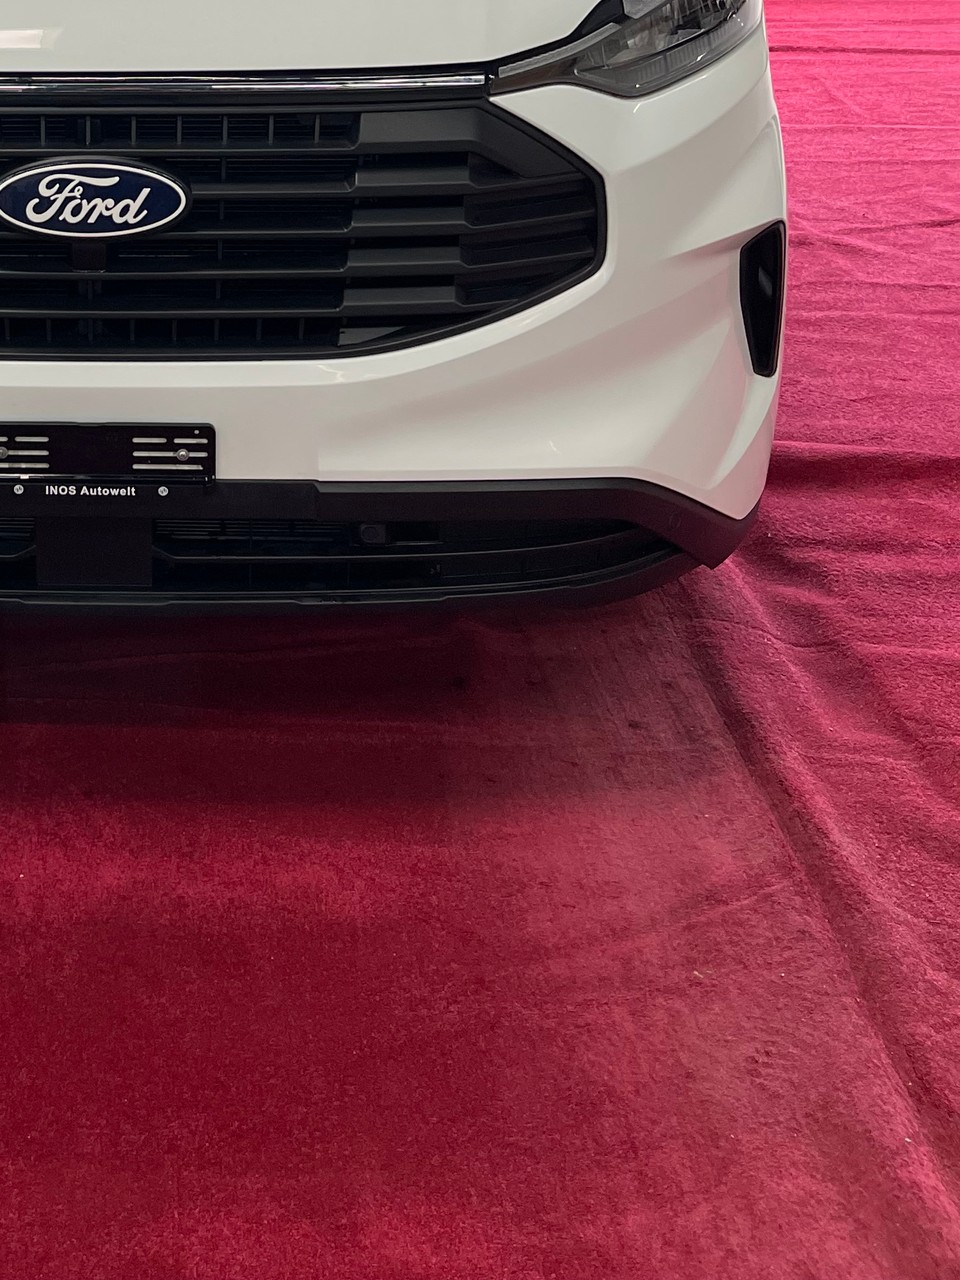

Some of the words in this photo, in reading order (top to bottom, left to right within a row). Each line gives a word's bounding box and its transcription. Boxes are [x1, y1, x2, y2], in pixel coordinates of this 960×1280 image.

[25, 173, 151, 225] Ford
[45, 485, 77, 496] INOS
[80, 485, 136, 496] Autowelt
